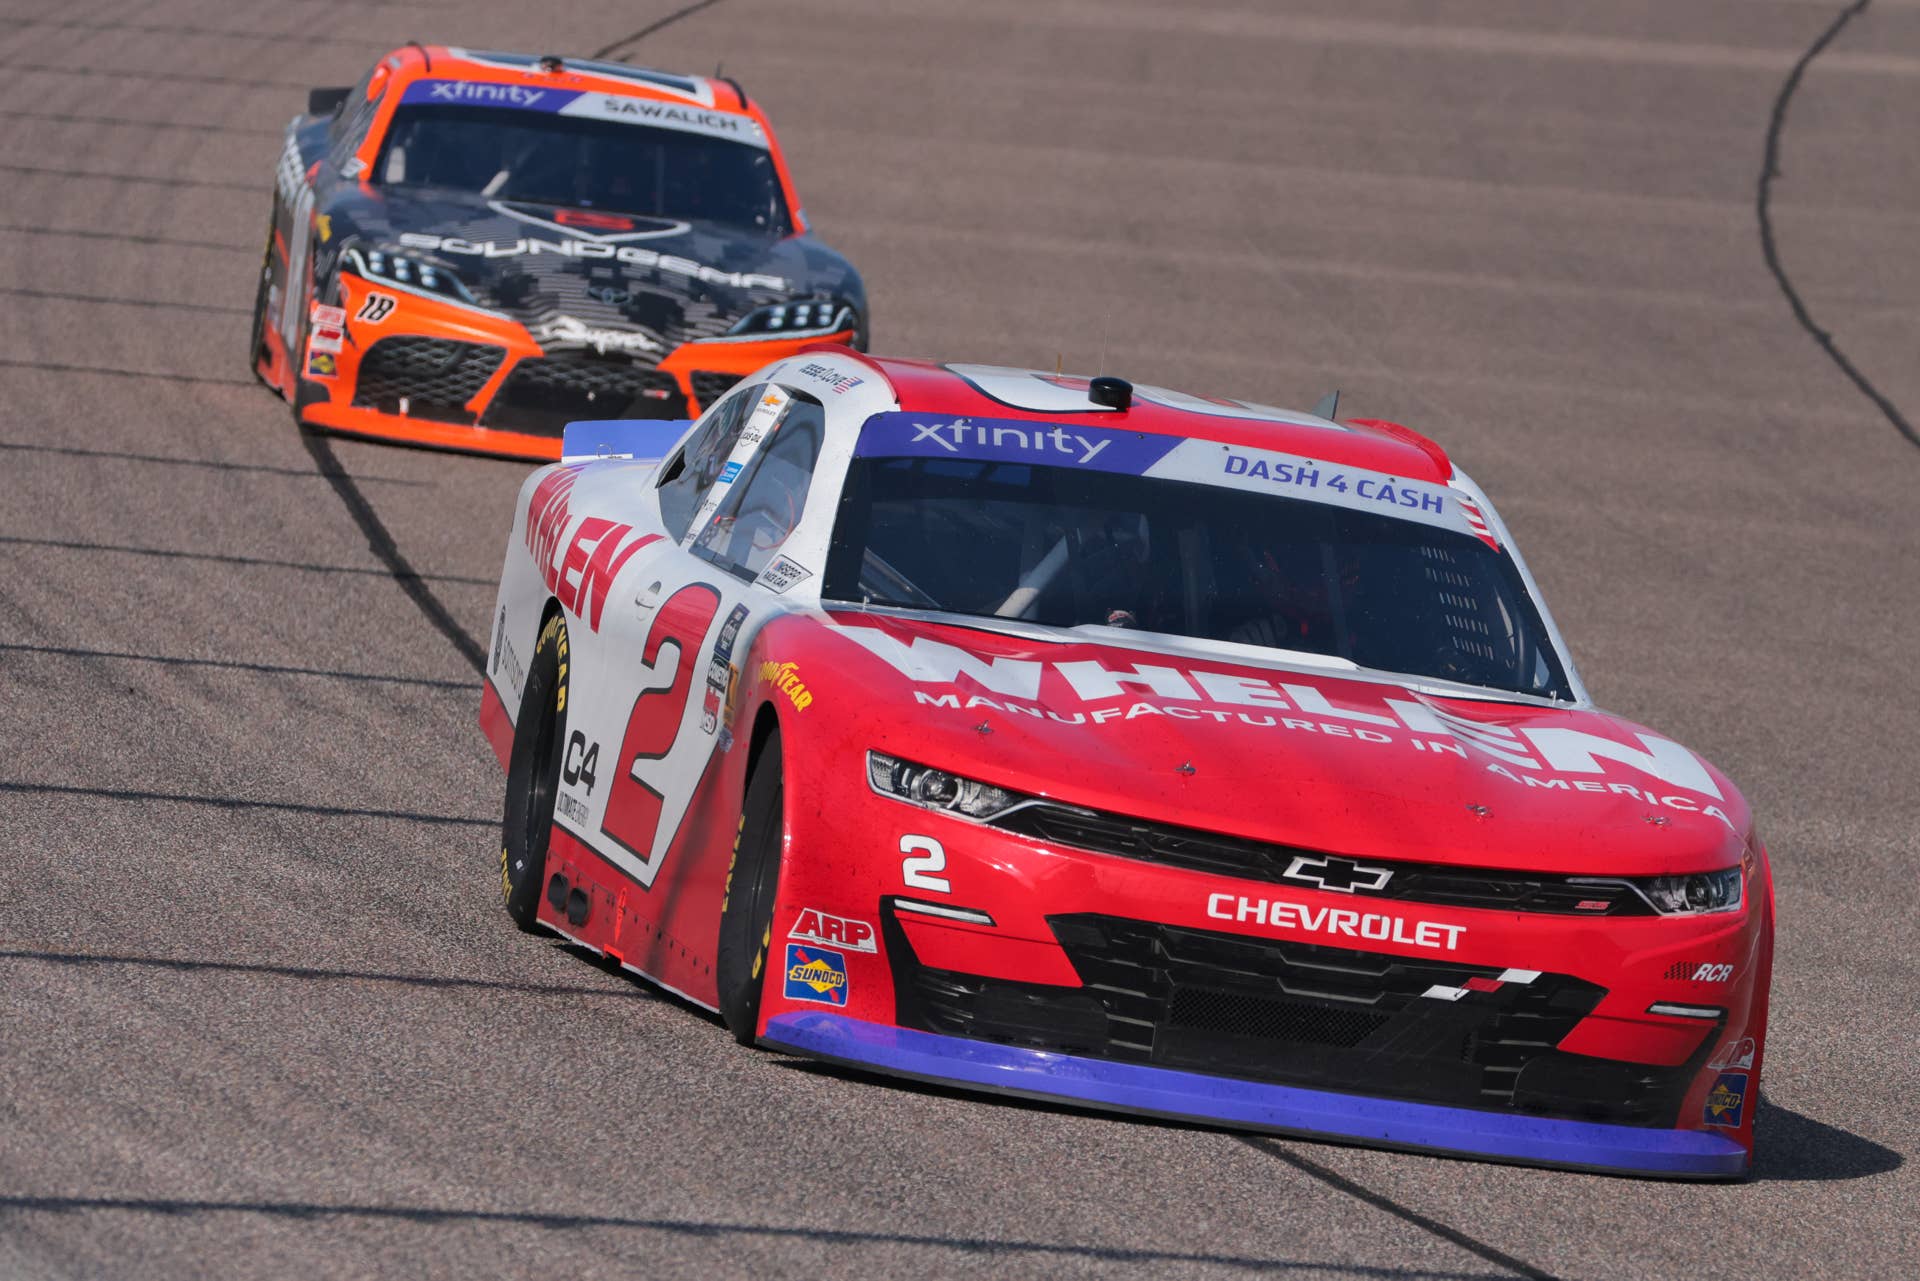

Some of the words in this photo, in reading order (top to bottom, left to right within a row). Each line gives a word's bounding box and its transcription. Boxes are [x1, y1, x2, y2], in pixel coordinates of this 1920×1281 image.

[431, 82, 545, 105] xfinity
[604, 98, 738, 131] SAWALICH
[355, 293, 396, 322] 18
[911, 417, 1111, 465] xfinity
[1224, 454, 1318, 488] DASH
[1327, 472, 1349, 493] 4
[1356, 479, 1445, 515] CASH
[600, 581, 722, 866] 2
[824, 624, 1726, 802] WHELEN
[563, 730, 600, 796] C4
[913, 690, 1393, 743] MANUFACTURED
[1411, 739, 1468, 760] IN
[1486, 764, 1735, 831] AMERICA
[899, 834, 951, 893] 2
[794, 910, 872, 945] ARP
[1207, 892, 1467, 950] CHEVROLET
[791, 966, 844, 987] SUNOCO
[1691, 963, 1734, 982] RCR
